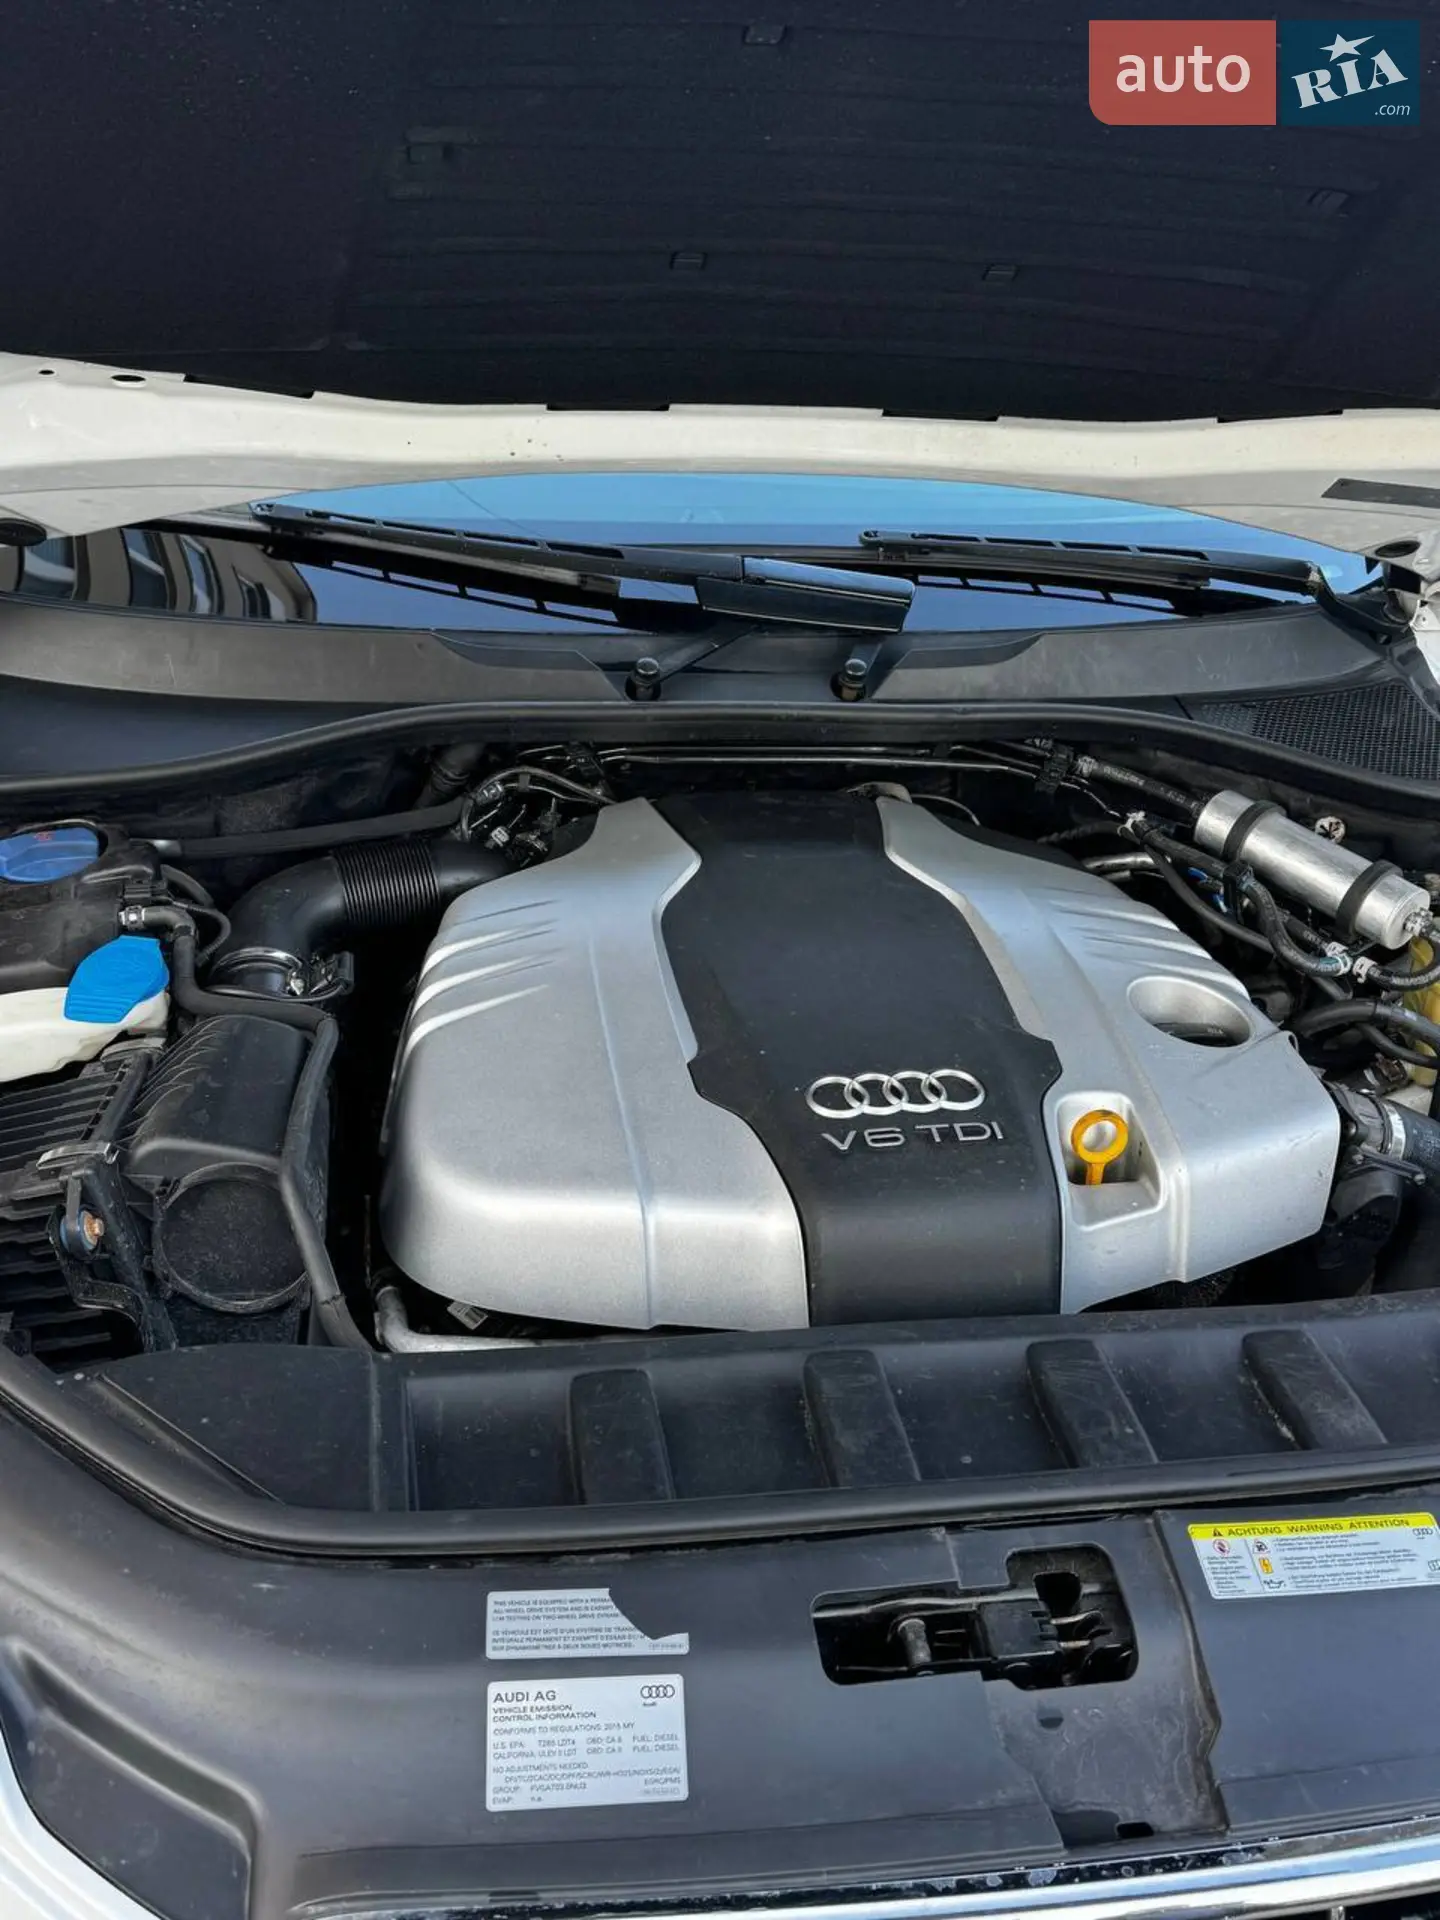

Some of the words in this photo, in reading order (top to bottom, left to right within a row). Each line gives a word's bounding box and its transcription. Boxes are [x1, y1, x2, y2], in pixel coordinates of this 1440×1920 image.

[821, 1127, 905, 1151] V6
[914, 1121, 1004, 1143] TDI
[1227, 1525, 1282, 1537] ACHTUNG
[1288, 1521, 1344, 1534] WARNING
[1349, 1518, 1410, 1530] ATTENTION
[493, 1691, 530, 1703] AUDI
[534, 1690, 557, 1702] AG
[492, 1706, 529, 1714] VEHICLE
[530, 1704, 573, 1712] EMISSION
[493, 1714, 534, 1723] CONTROL
[535, 1711, 597, 1721] INFORMATION
[493, 1727, 537, 1736] CONFORMS
[550, 1723, 602, 1733] REGULATIONS
